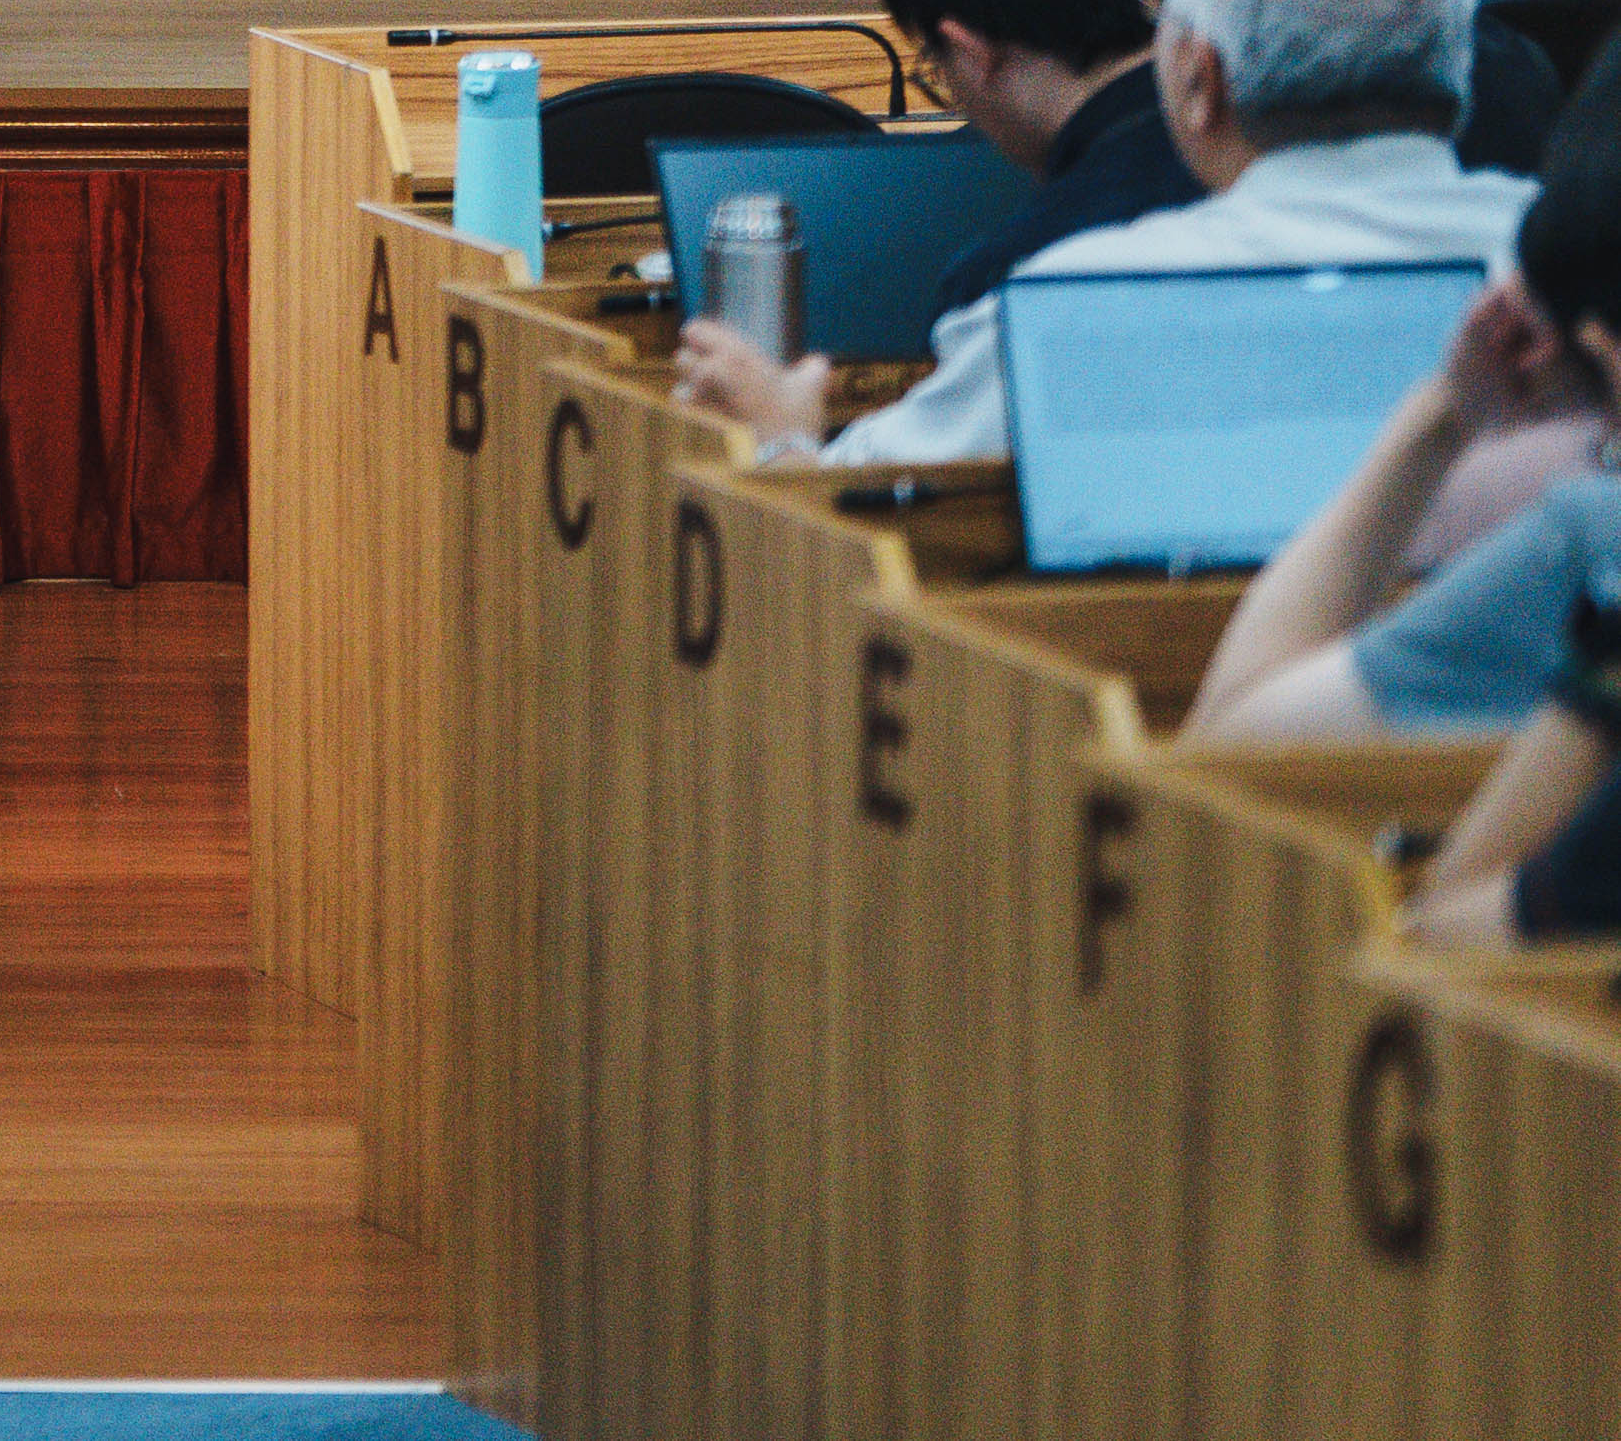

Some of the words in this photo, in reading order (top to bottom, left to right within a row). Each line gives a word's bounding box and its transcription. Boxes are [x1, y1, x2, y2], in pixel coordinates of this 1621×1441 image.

[363, 236, 400, 364] A
[447, 313, 487, 453] B
[546, 397, 595, 550] C
[672, 499, 724, 673] D
[857, 634, 916, 836] E
[1078, 789, 1139, 995] F
[1345, 1009, 1442, 1265] G
